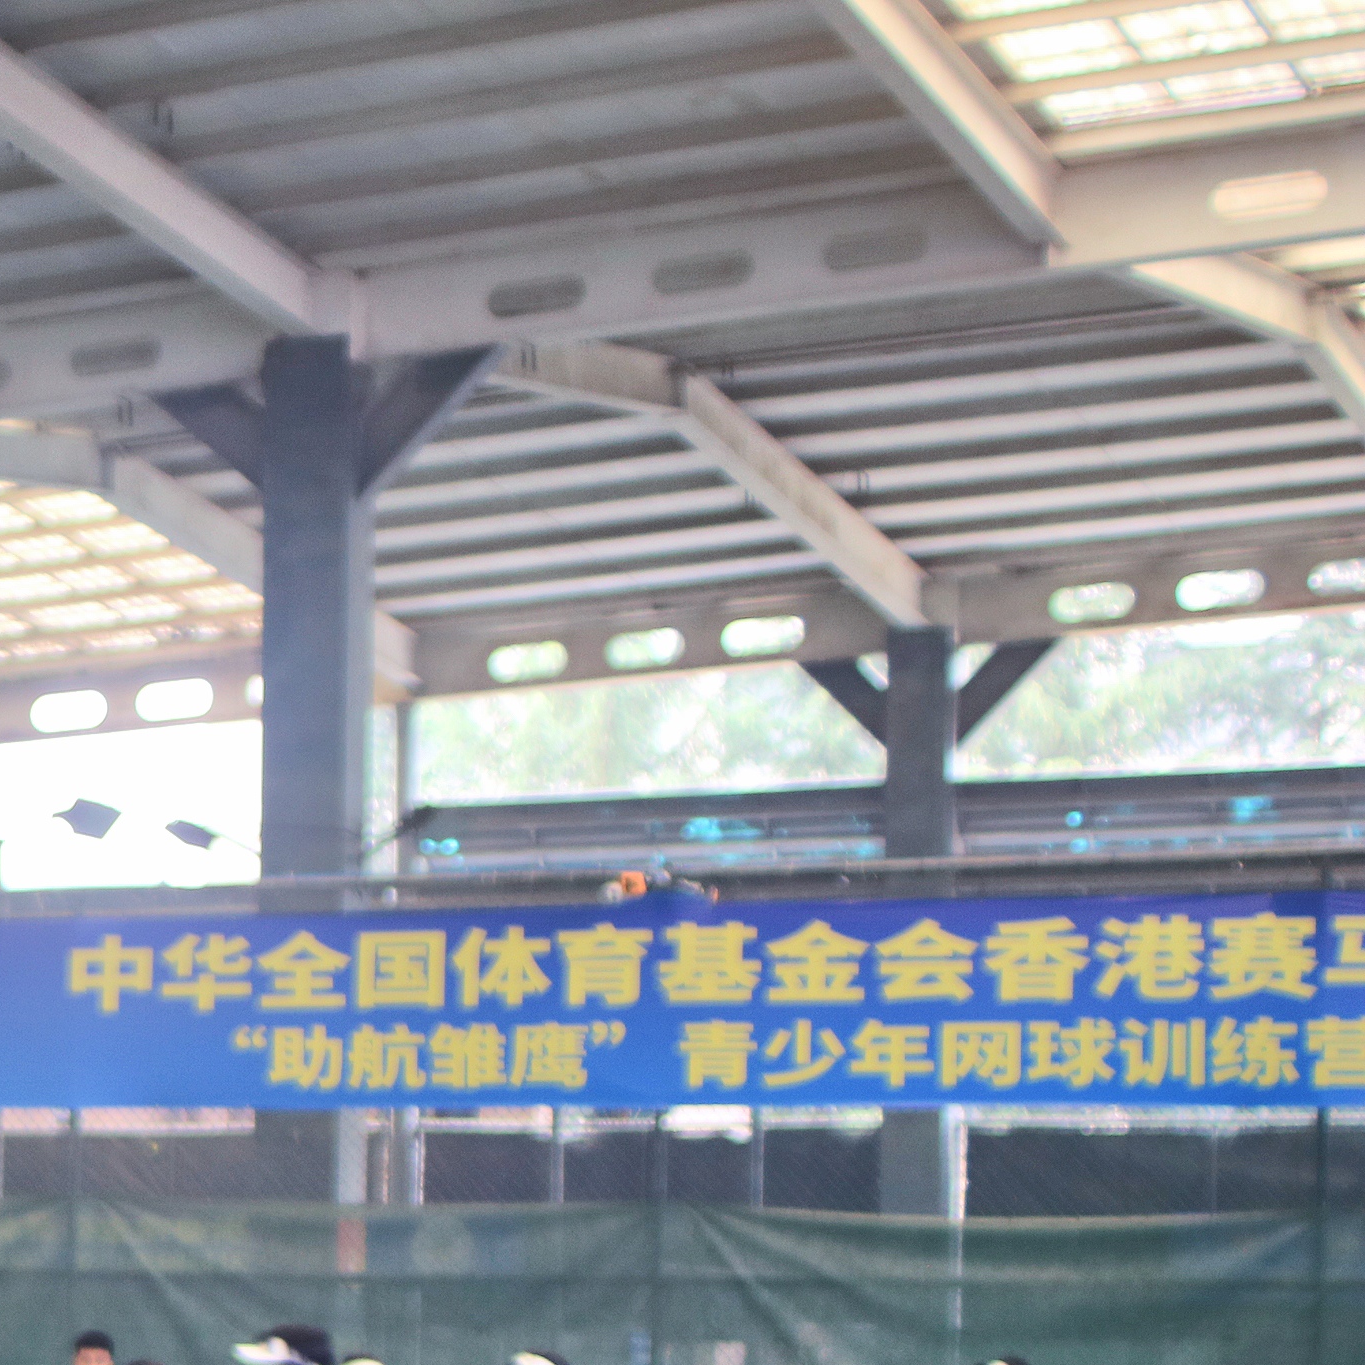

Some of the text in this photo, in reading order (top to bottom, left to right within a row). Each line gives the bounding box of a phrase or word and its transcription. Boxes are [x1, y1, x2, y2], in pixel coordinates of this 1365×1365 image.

[234, 1016, 1365, 1088] “助航雏鹰” 青少年网球训练营
